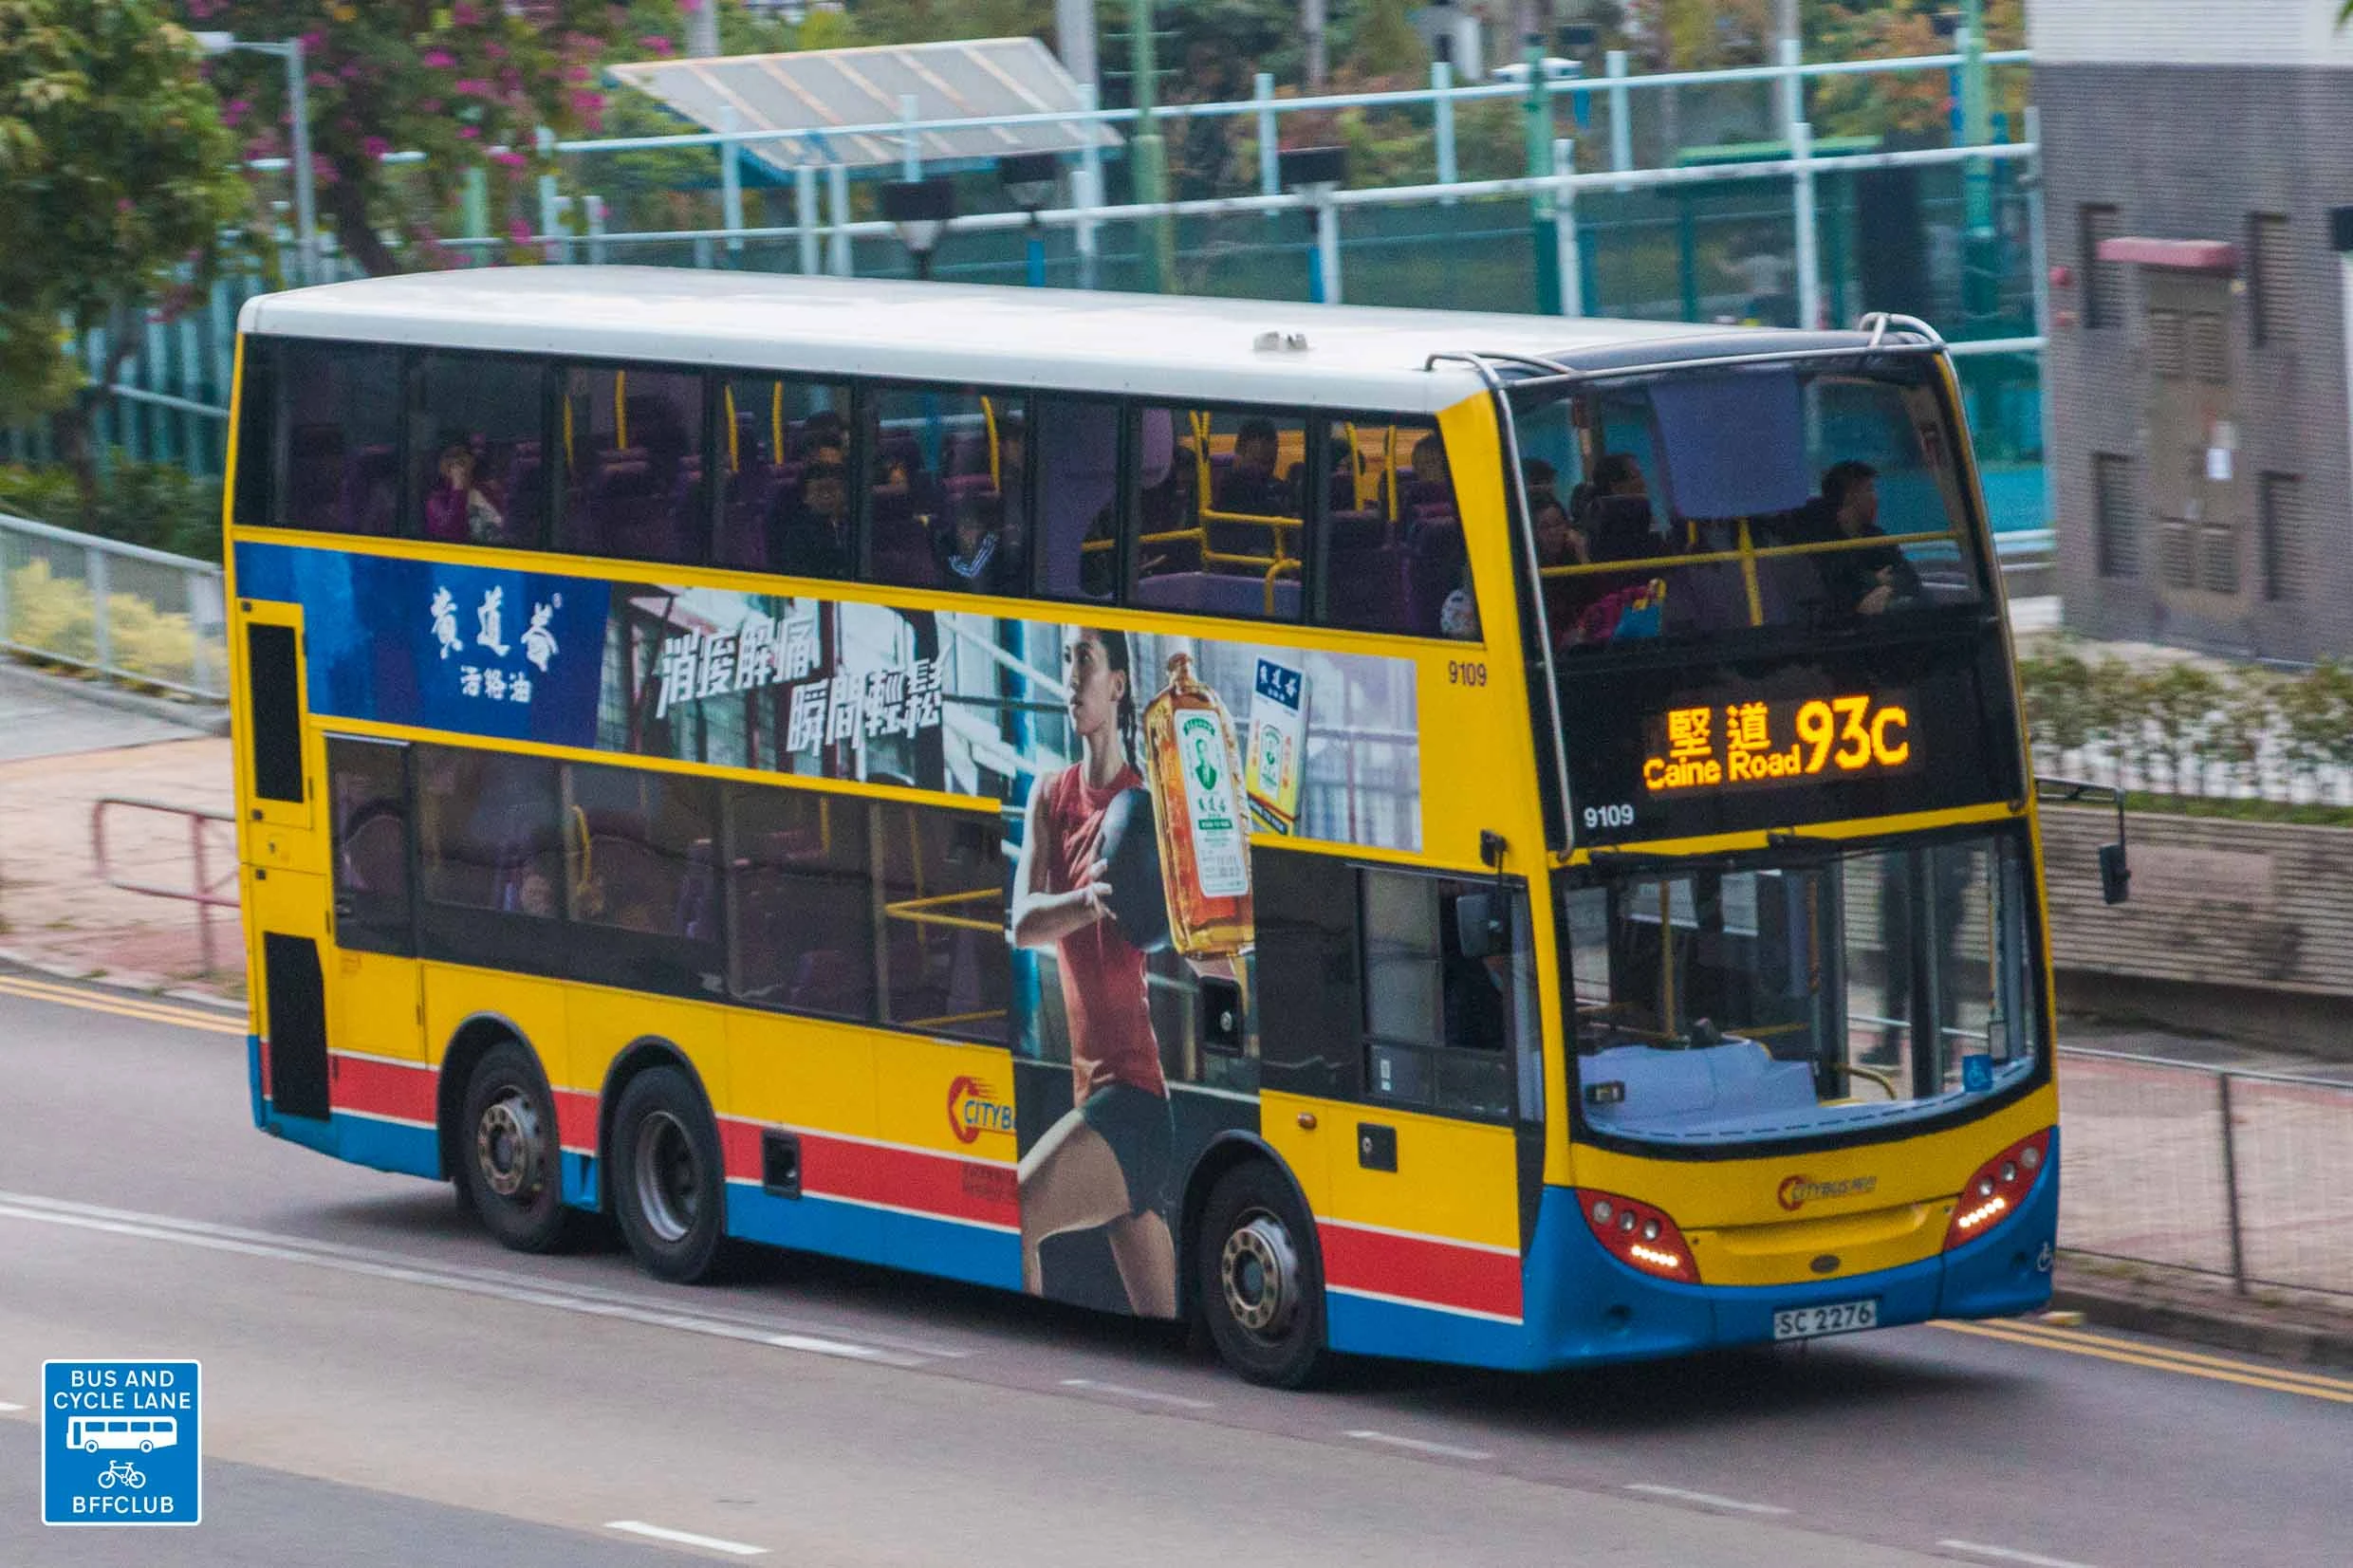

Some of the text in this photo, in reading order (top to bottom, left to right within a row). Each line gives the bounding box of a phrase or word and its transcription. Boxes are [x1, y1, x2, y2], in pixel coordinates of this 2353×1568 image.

[1448, 659, 1488, 688] 9109
[786, 656, 943, 757] 瞬間輕鬆
[1668, 700, 1771, 758] 堅道
[1795, 694, 1909, 775] 93C
[1642, 743, 1802, 790] Caine Road
[1584, 803, 1634, 828] 9109
[963, 1098, 1017, 1131] CITYB
[1779, 1304, 1871, 1335] SC 2276
